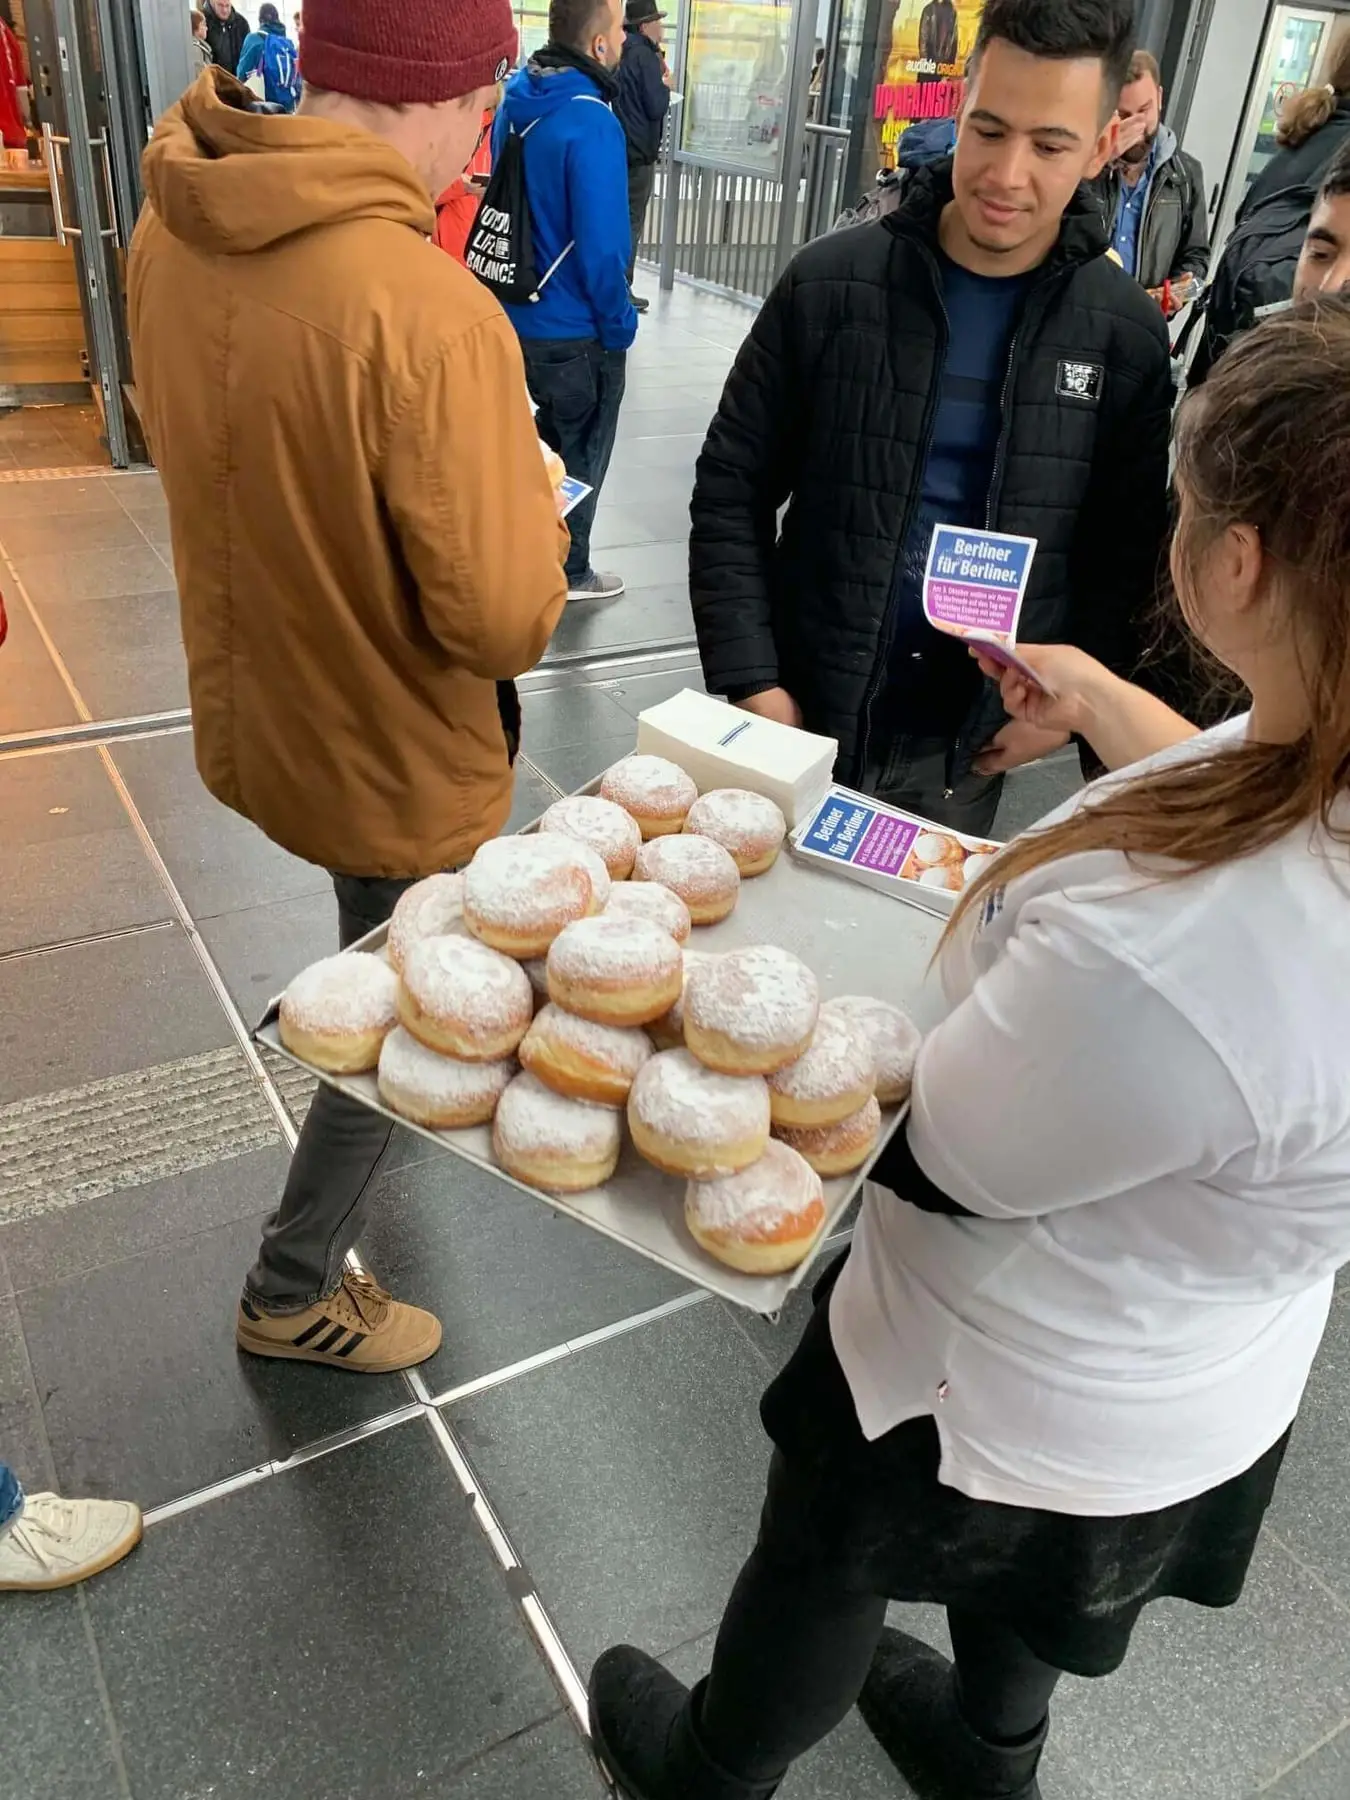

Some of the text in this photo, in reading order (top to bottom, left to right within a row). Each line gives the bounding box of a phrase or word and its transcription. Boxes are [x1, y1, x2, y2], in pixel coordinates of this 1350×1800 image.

[906, 58, 936, 74] audible
[874, 83, 894, 118] UP
[894, 80, 953, 118] AGAINST
[472, 229, 496, 255] LIFE
[466, 250, 516, 284] BALANCE
[954, 538, 1013, 562] Berliner
[936, 555, 1018, 584] für Berliner.
[813, 807, 844, 842] Berliner
[829, 809, 868, 856] für Berliner.
